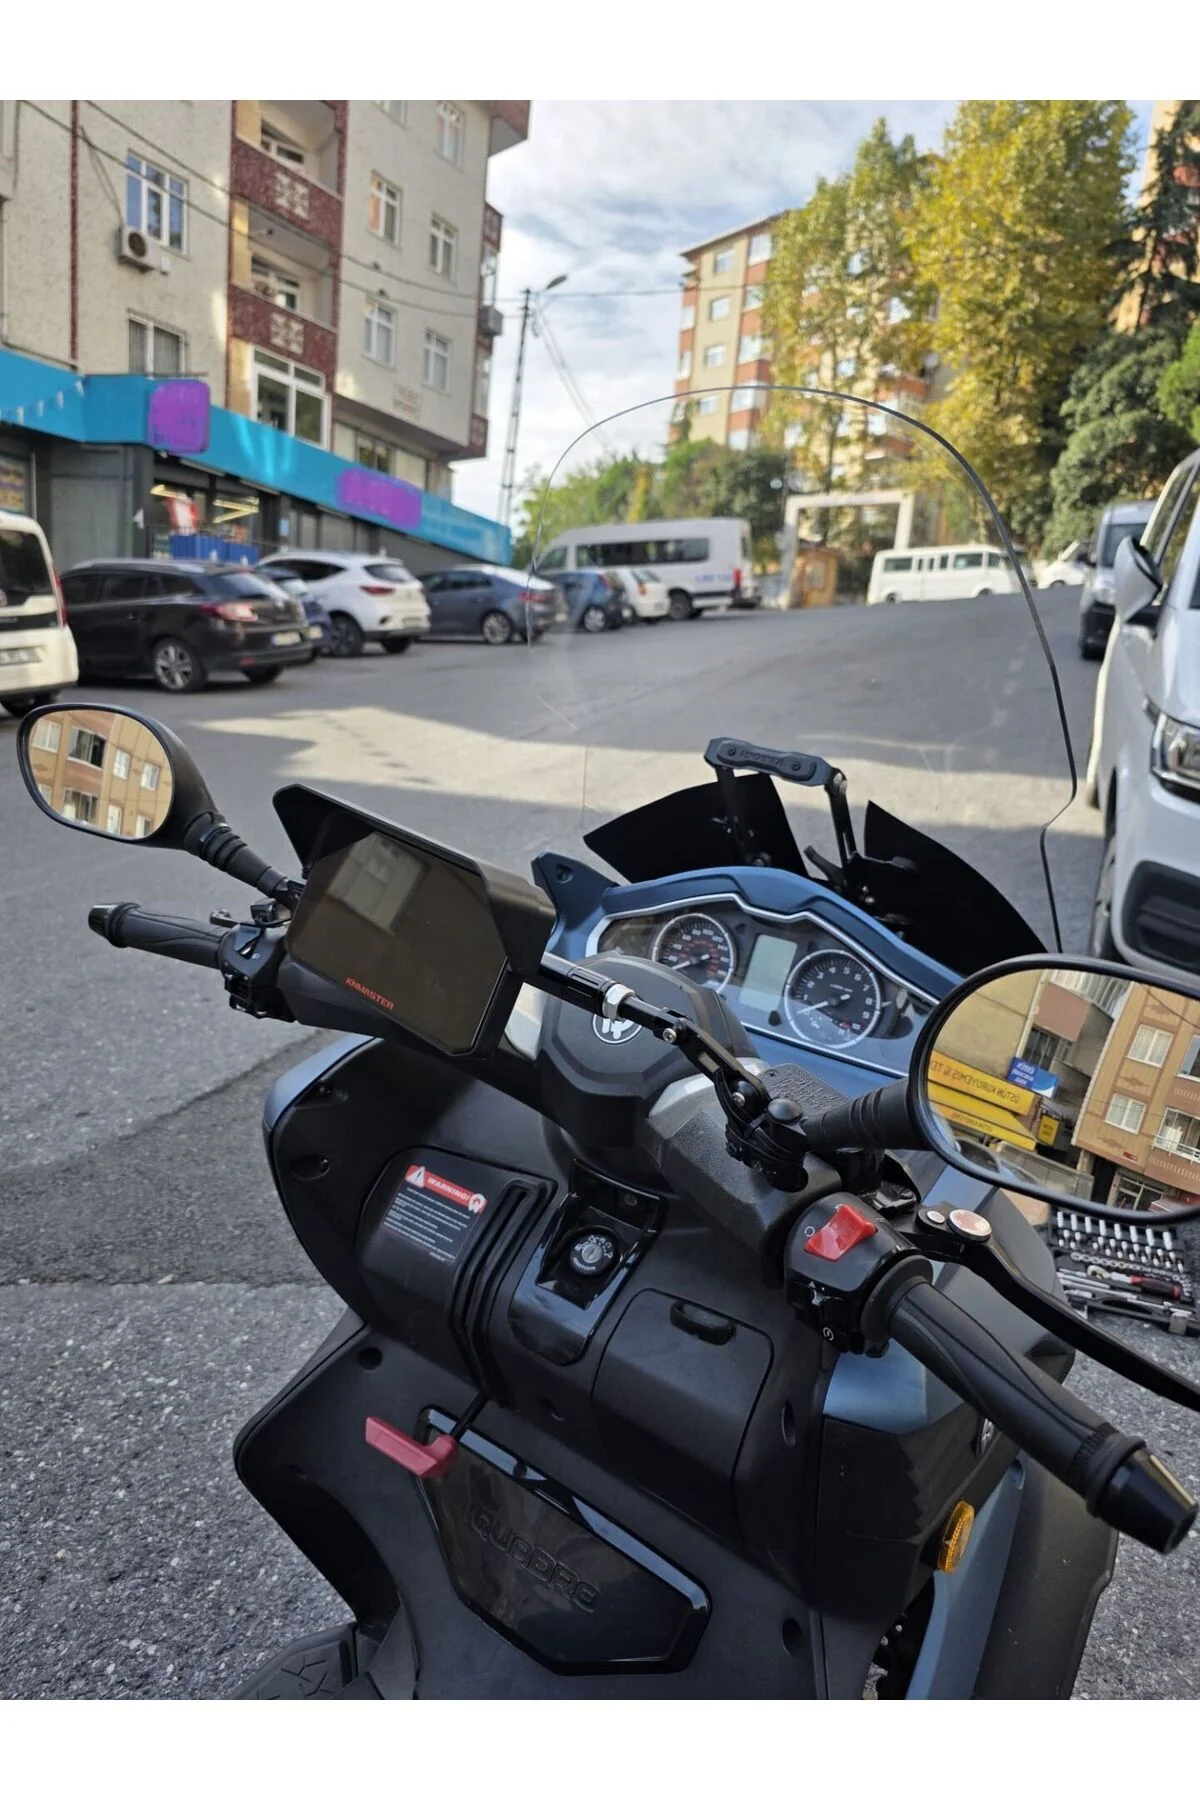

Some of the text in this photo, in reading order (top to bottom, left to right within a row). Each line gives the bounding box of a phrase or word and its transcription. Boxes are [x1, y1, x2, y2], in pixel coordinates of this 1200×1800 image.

[828, 966, 836, 974] 4
[843, 966, 851, 974] 5
[854, 973, 861, 981] 6
[865, 998, 873, 1006] 8
[862, 1011, 870, 1019] 9
[852, 1022, 860, 1030] 10
[428, 1177, 471, 1201] WARNING!
[469, 1507, 601, 1613] QUADRO
